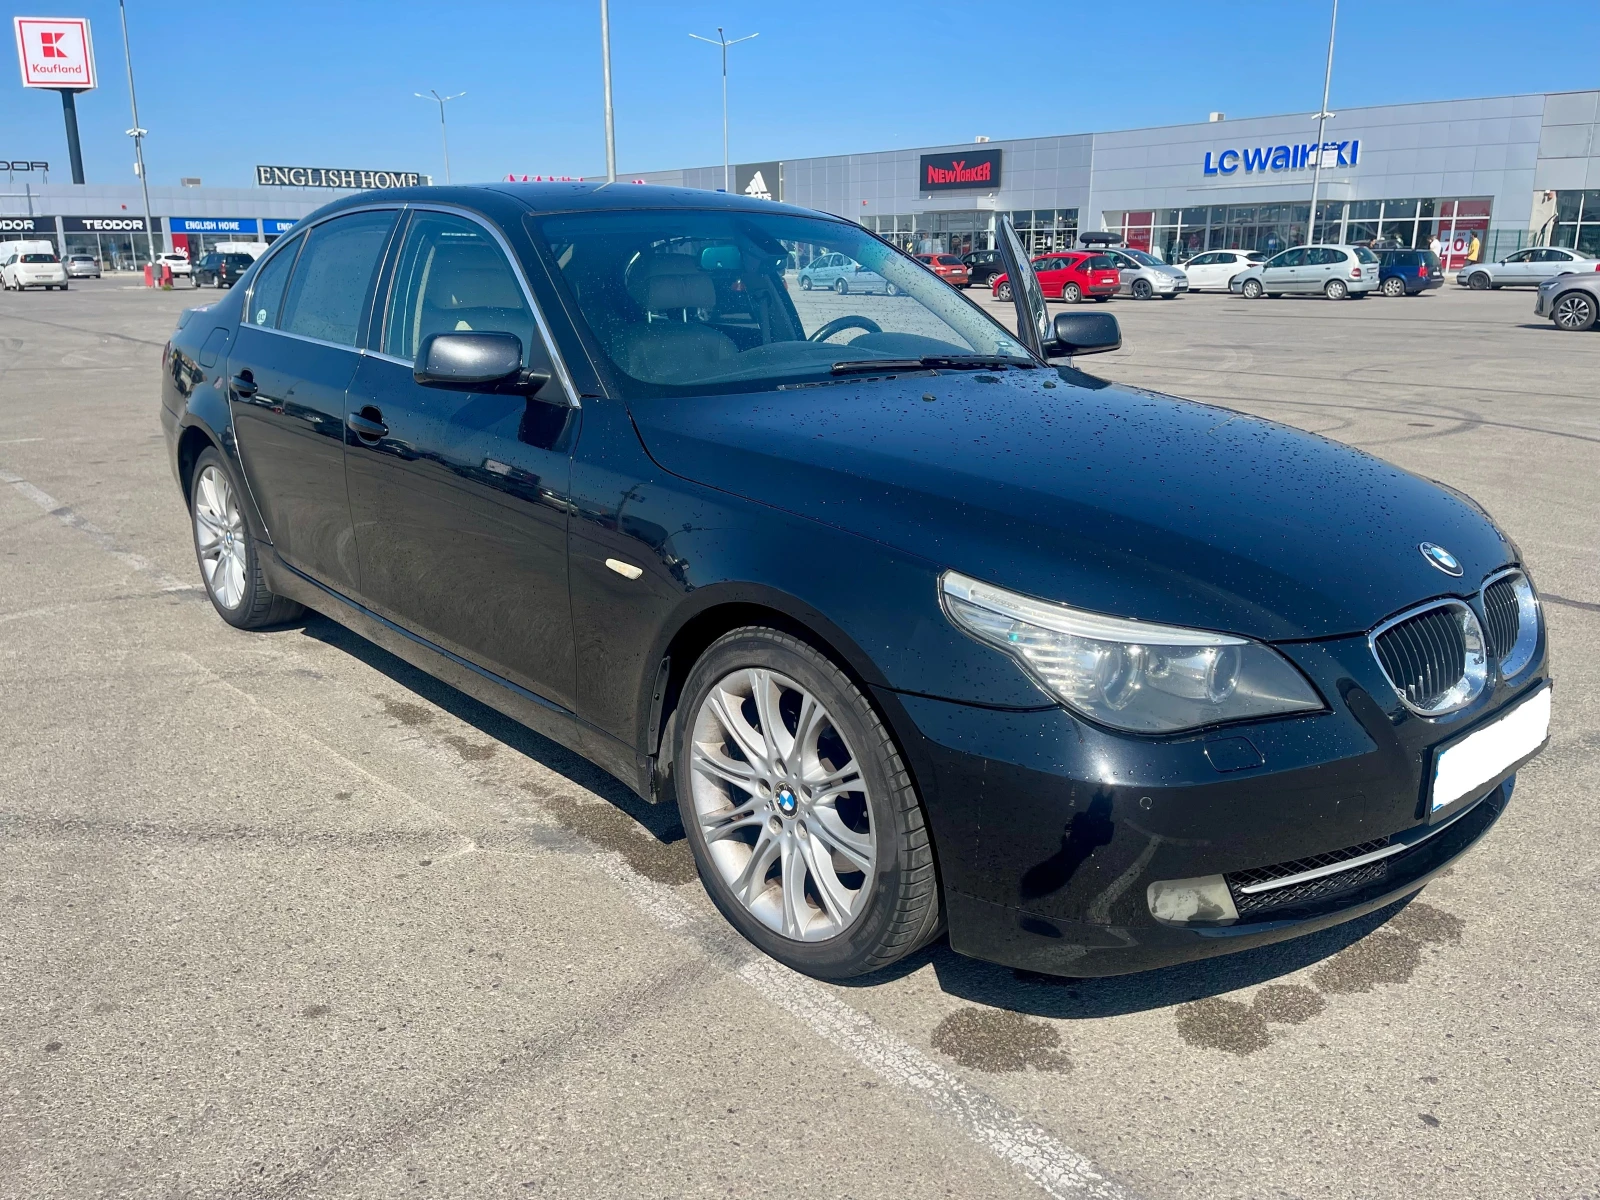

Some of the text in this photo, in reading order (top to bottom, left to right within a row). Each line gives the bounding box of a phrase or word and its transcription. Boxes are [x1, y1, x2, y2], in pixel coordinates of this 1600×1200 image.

[32, 63, 82, 74] Kaufland
[1203, 149, 1240, 175] LC
[258, 166, 419, 189] ENGLISH HOME
[0, 219, 35, 230] DOR
[82, 219, 144, 230] TEODOR
[184, 221, 240, 230] ENGLISH HOME
